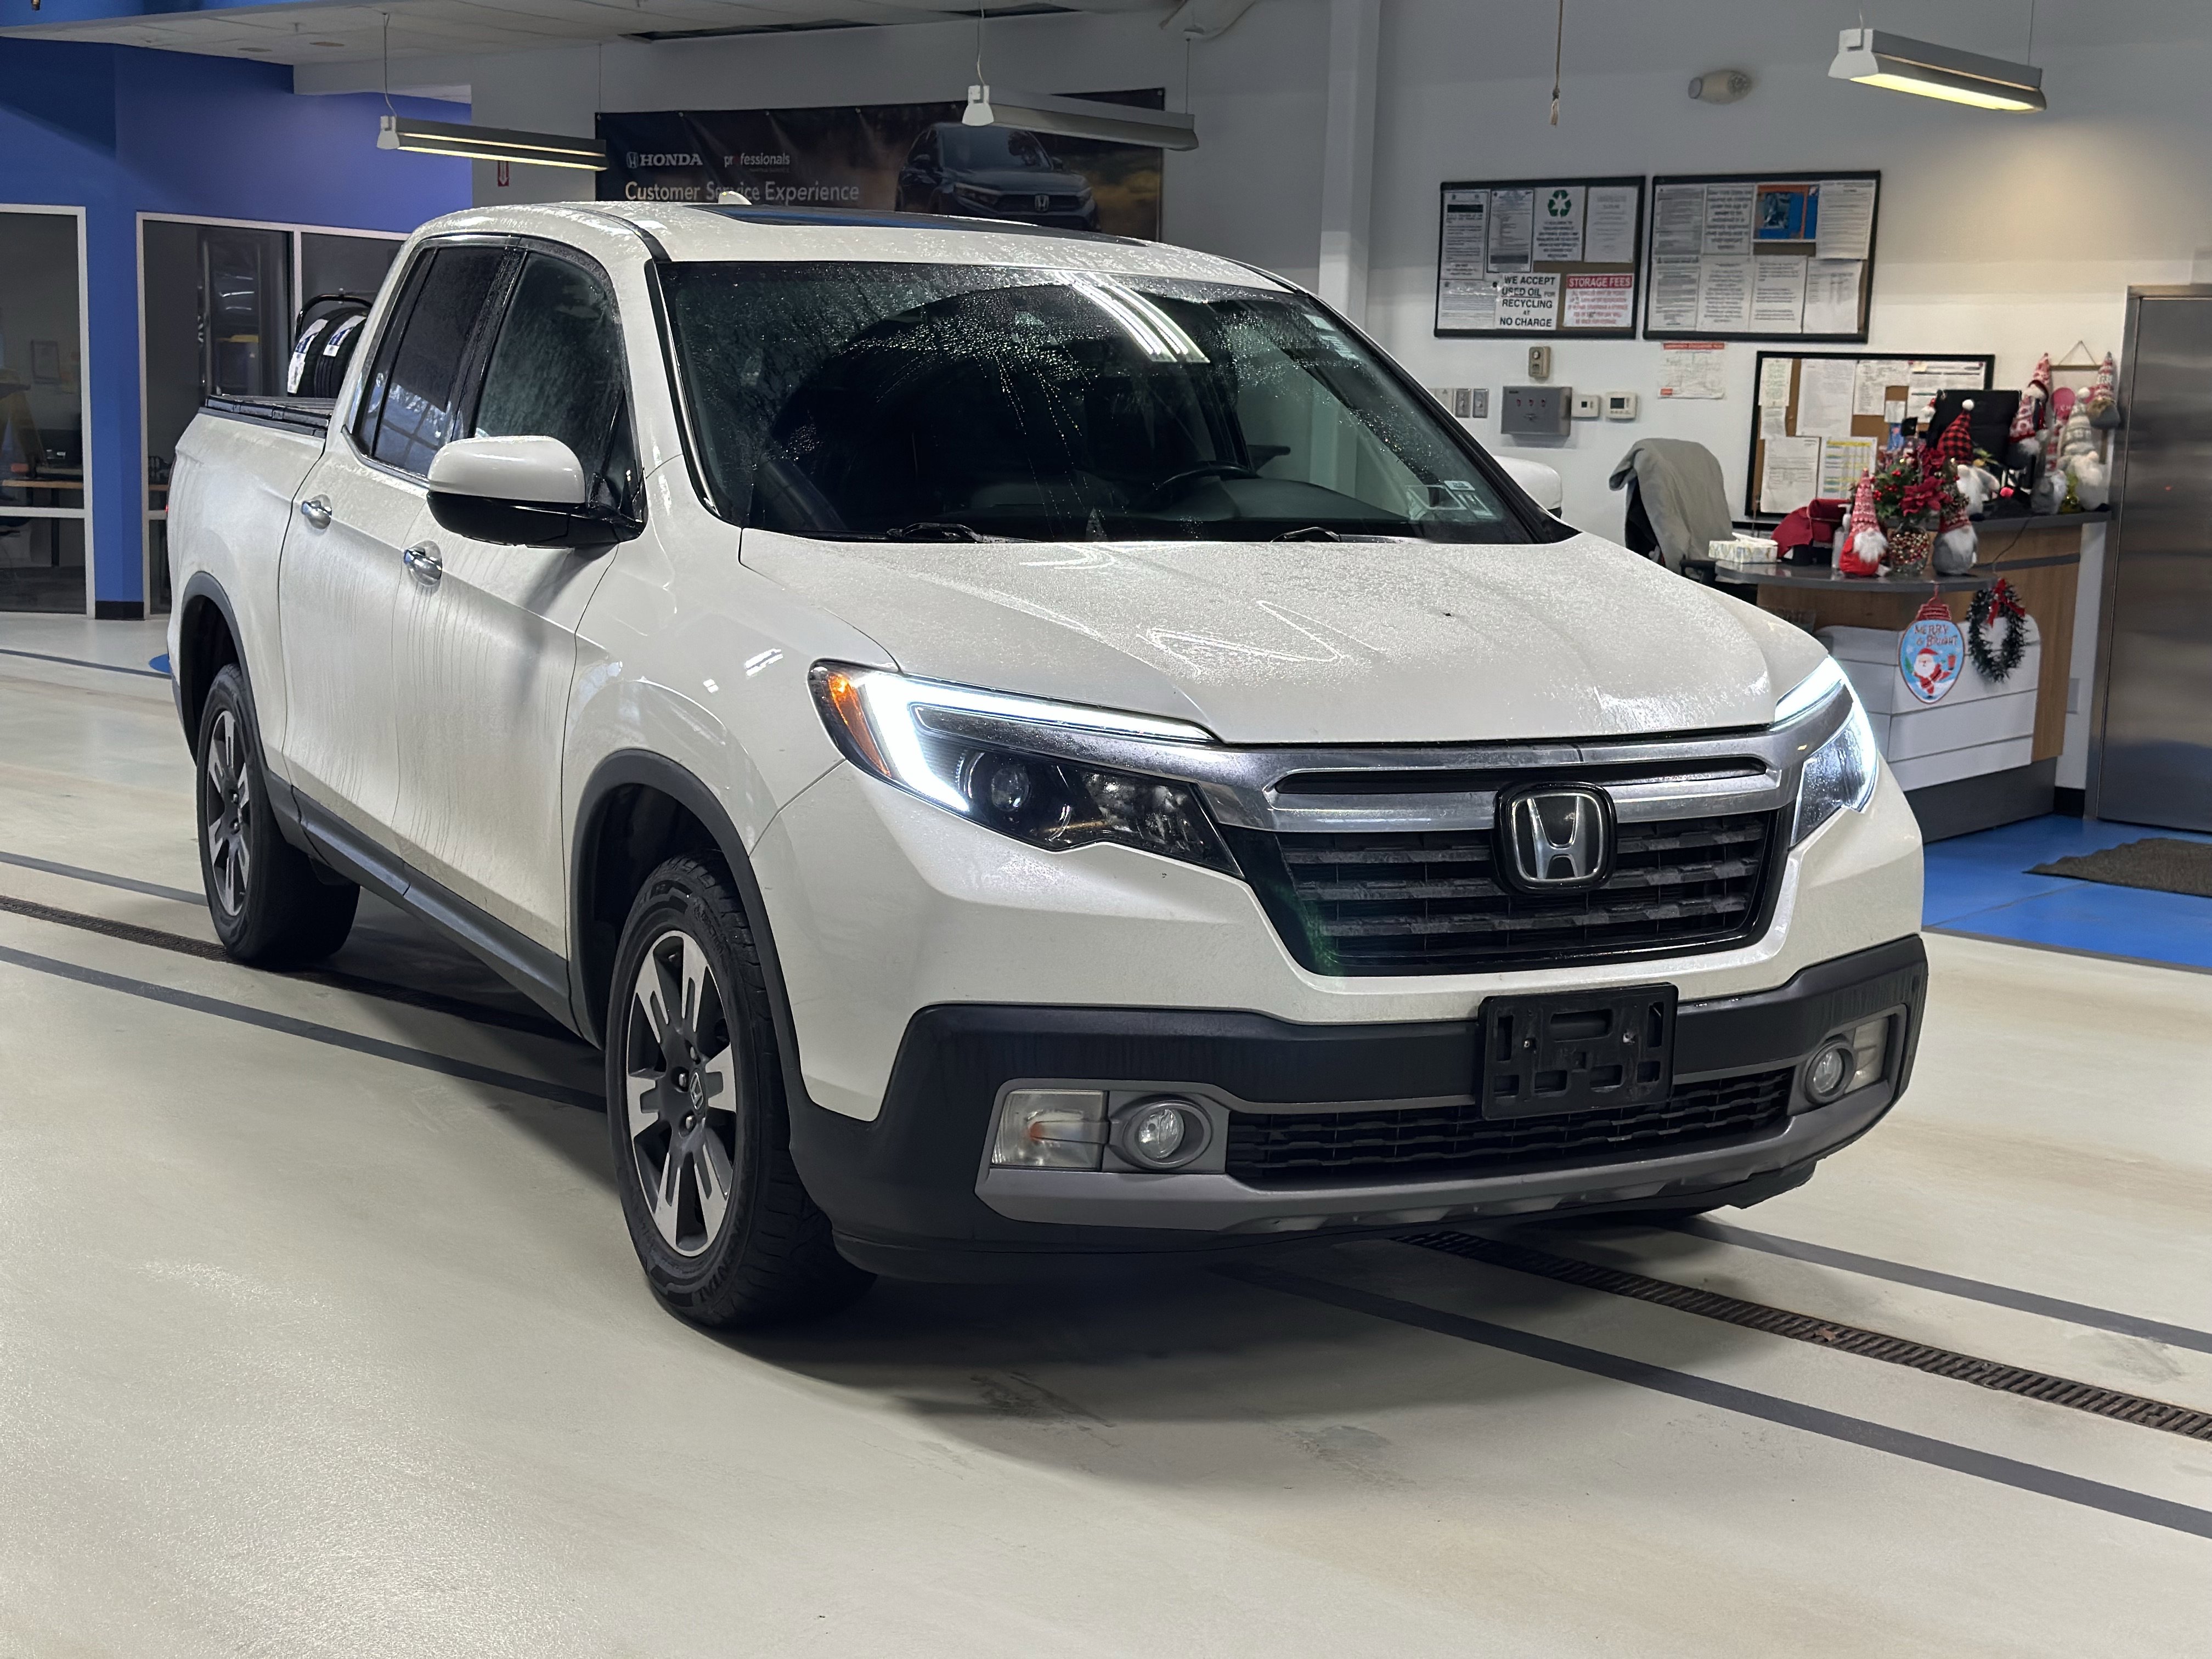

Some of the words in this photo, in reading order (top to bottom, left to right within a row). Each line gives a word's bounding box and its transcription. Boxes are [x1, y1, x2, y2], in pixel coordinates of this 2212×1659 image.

[640, 154, 703, 166] HONDA
[724, 152, 791, 168] prfessionals
[625, 181, 700, 201] Customer
[706, 180, 761, 201] Seice
[765, 180, 859, 206] Experience
[1504, 275, 1517, 284] WE
[1520, 276, 1556, 285] ACCEPT
[1568, 277, 1608, 287] STORAGE
[1609, 276, 1631, 286] FEES
[1528, 287, 1542, 297] OIL
[1502, 299, 1553, 308] RECYCLING
[1499, 317, 1513, 326] NO
[1515, 318, 1553, 328] CHARGE
